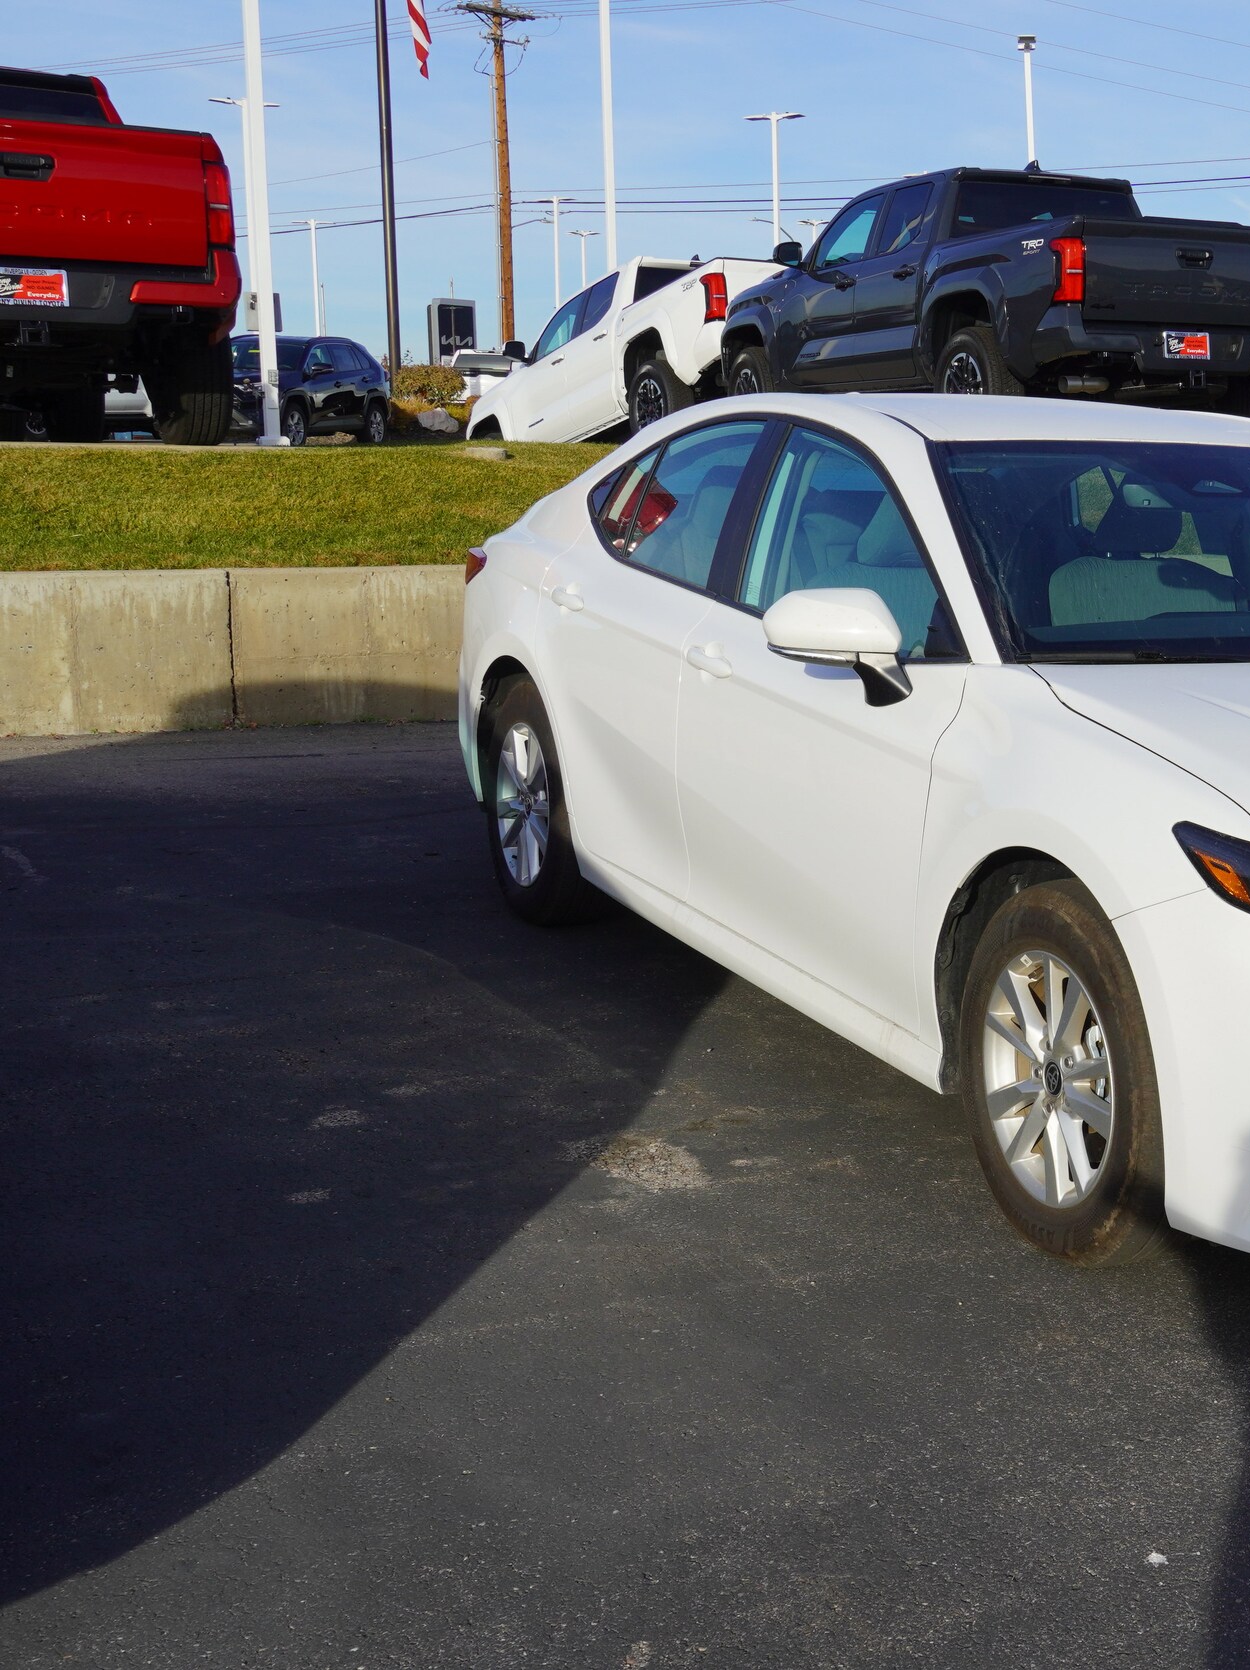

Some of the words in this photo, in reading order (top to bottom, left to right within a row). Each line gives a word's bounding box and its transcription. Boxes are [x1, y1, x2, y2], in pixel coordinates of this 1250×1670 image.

[1021, 238, 1044, 250] TRD
[26, 291, 62, 300] Everyday.
[441, 334, 473, 347] KIA
